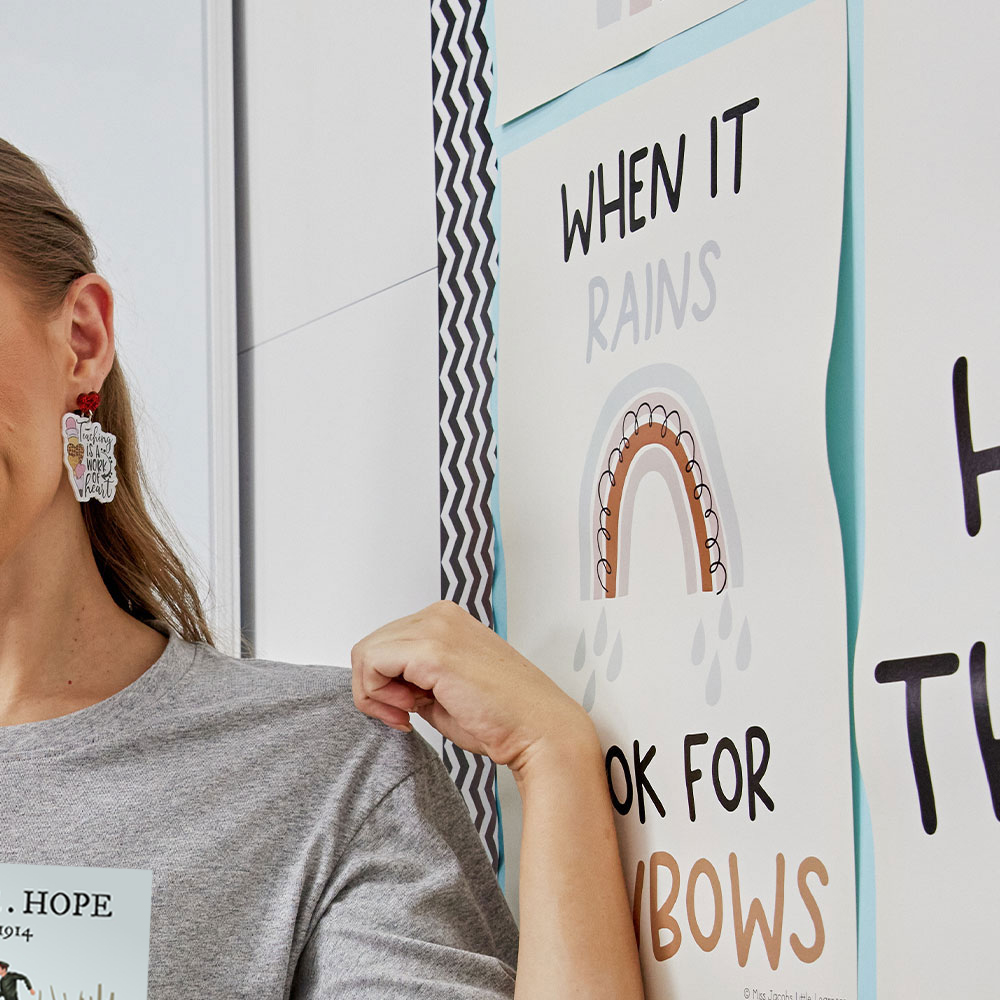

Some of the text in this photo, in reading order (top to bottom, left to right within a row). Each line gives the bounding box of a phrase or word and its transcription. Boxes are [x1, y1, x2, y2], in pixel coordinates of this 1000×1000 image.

[560, 97, 760, 263] WHEN IT
[584, 239, 722, 364] RAINS
[84, 472, 115, 499] heart
[86, 459, 107, 472] WORK
[604, 725, 775, 825] OK FOR
[22, 890, 114, 918] HOPE
[632, 850, 830, 972] BOWS
[752, 988, 766, 1000] Miss
